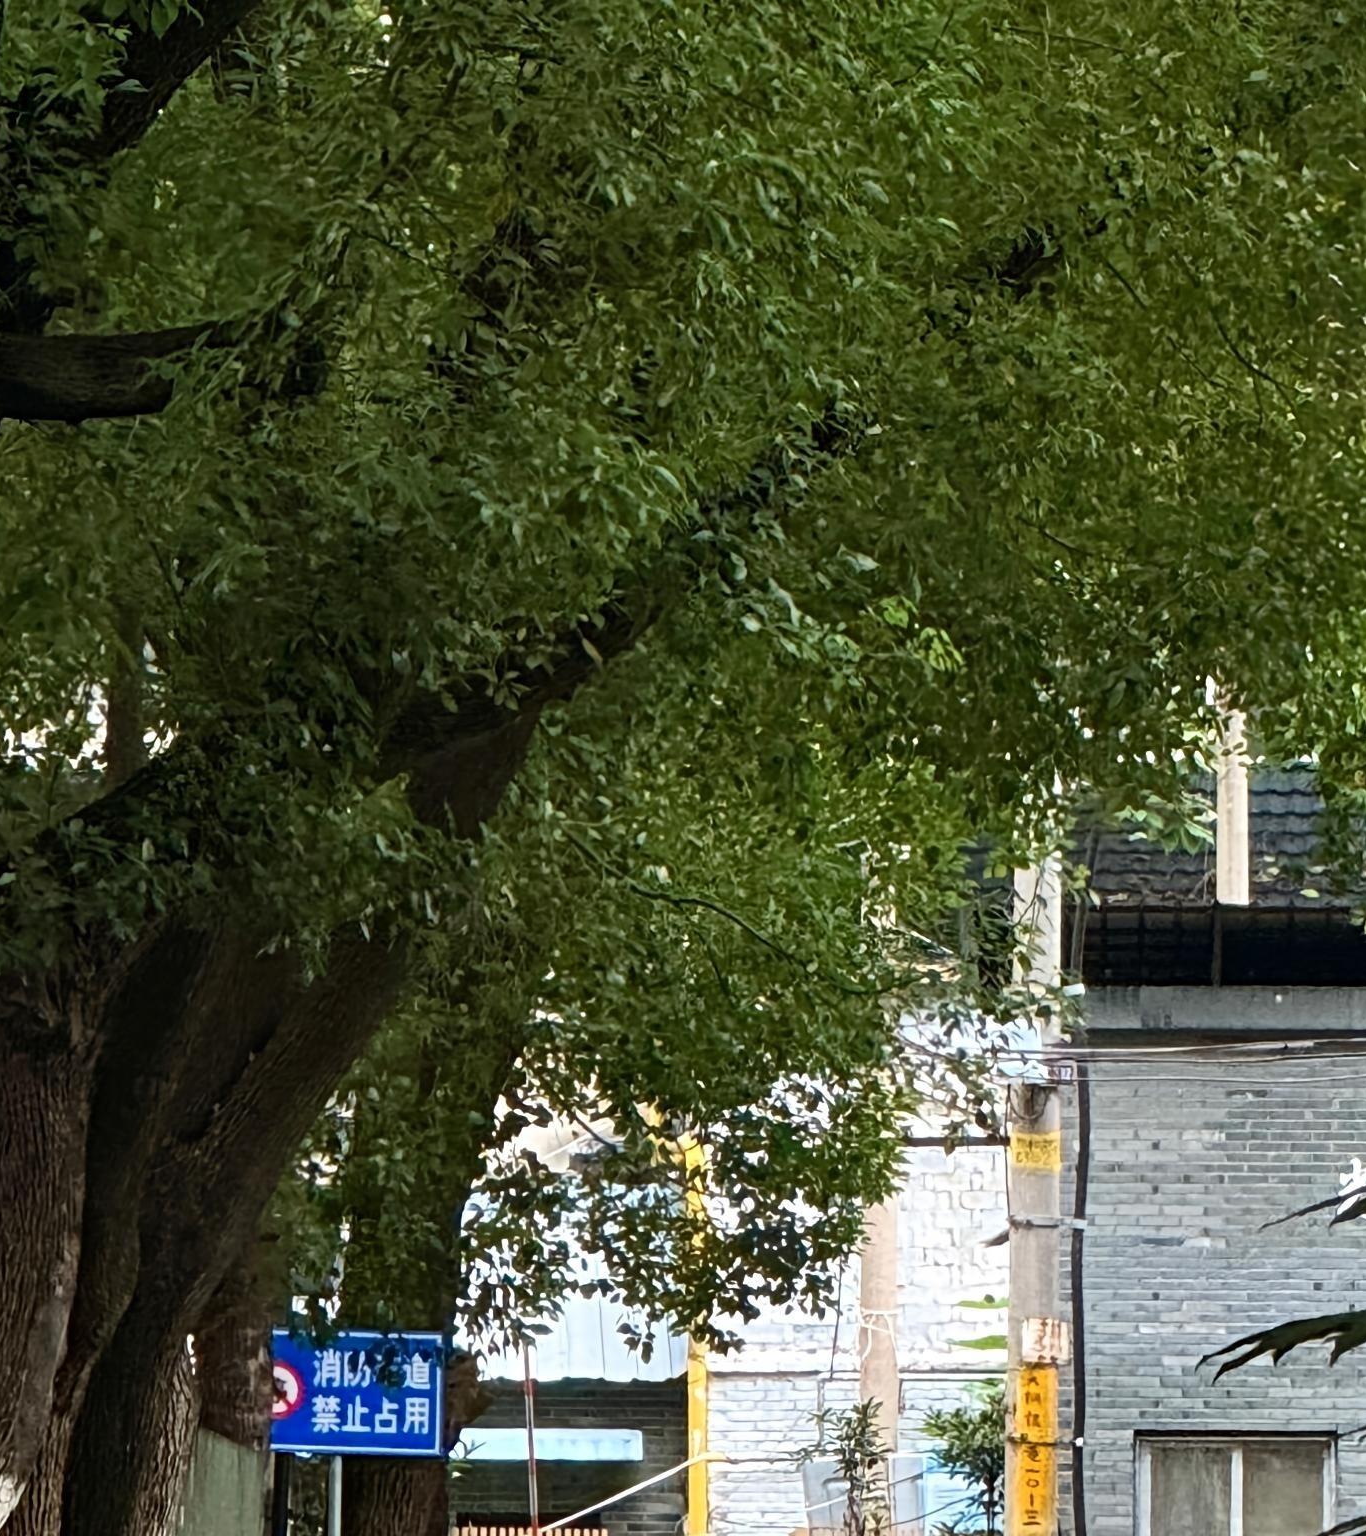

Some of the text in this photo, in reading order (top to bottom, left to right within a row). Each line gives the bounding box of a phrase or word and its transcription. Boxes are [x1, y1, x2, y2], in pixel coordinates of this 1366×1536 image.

[312, 1348, 431, 1389] 消防道
[311, 1394, 430, 1434] 禁止占用
